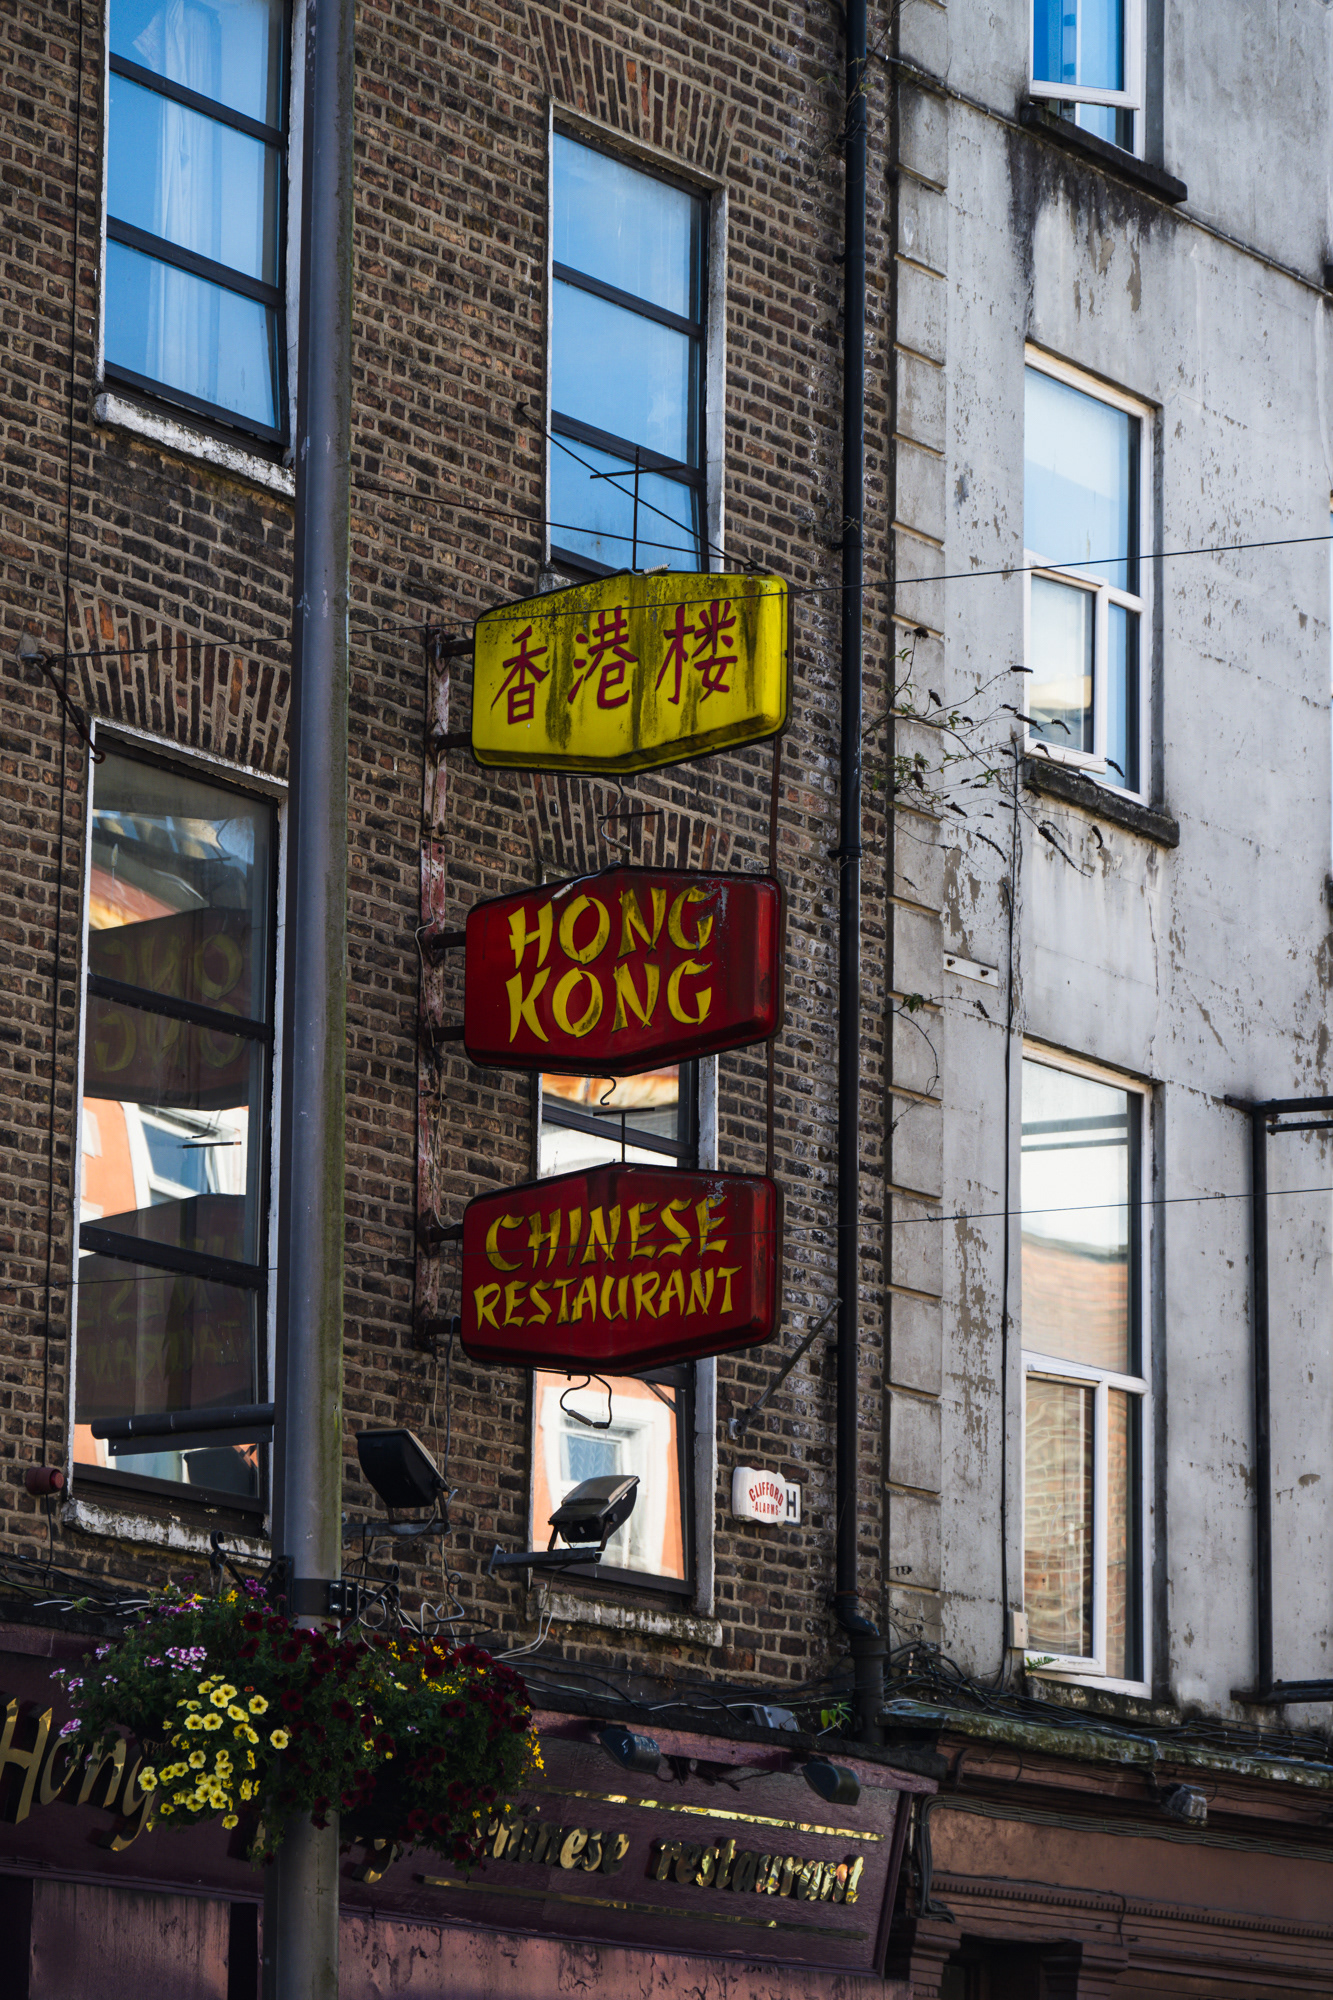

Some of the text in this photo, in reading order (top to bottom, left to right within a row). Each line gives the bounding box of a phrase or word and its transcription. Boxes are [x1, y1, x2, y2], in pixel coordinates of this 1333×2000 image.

[491, 601, 738, 724] 香港楼
[507, 885, 715, 969] HONG
[505, 958, 712, 1043] KONG
[485, 1195, 728, 1272] CHINESE
[473, 1265, 742, 1331] RESTAURANT
[748, 1481, 784, 1507] CLIFFORD
[786, 1489, 797, 1518] H
[655, 1838, 864, 1904] restaurant
